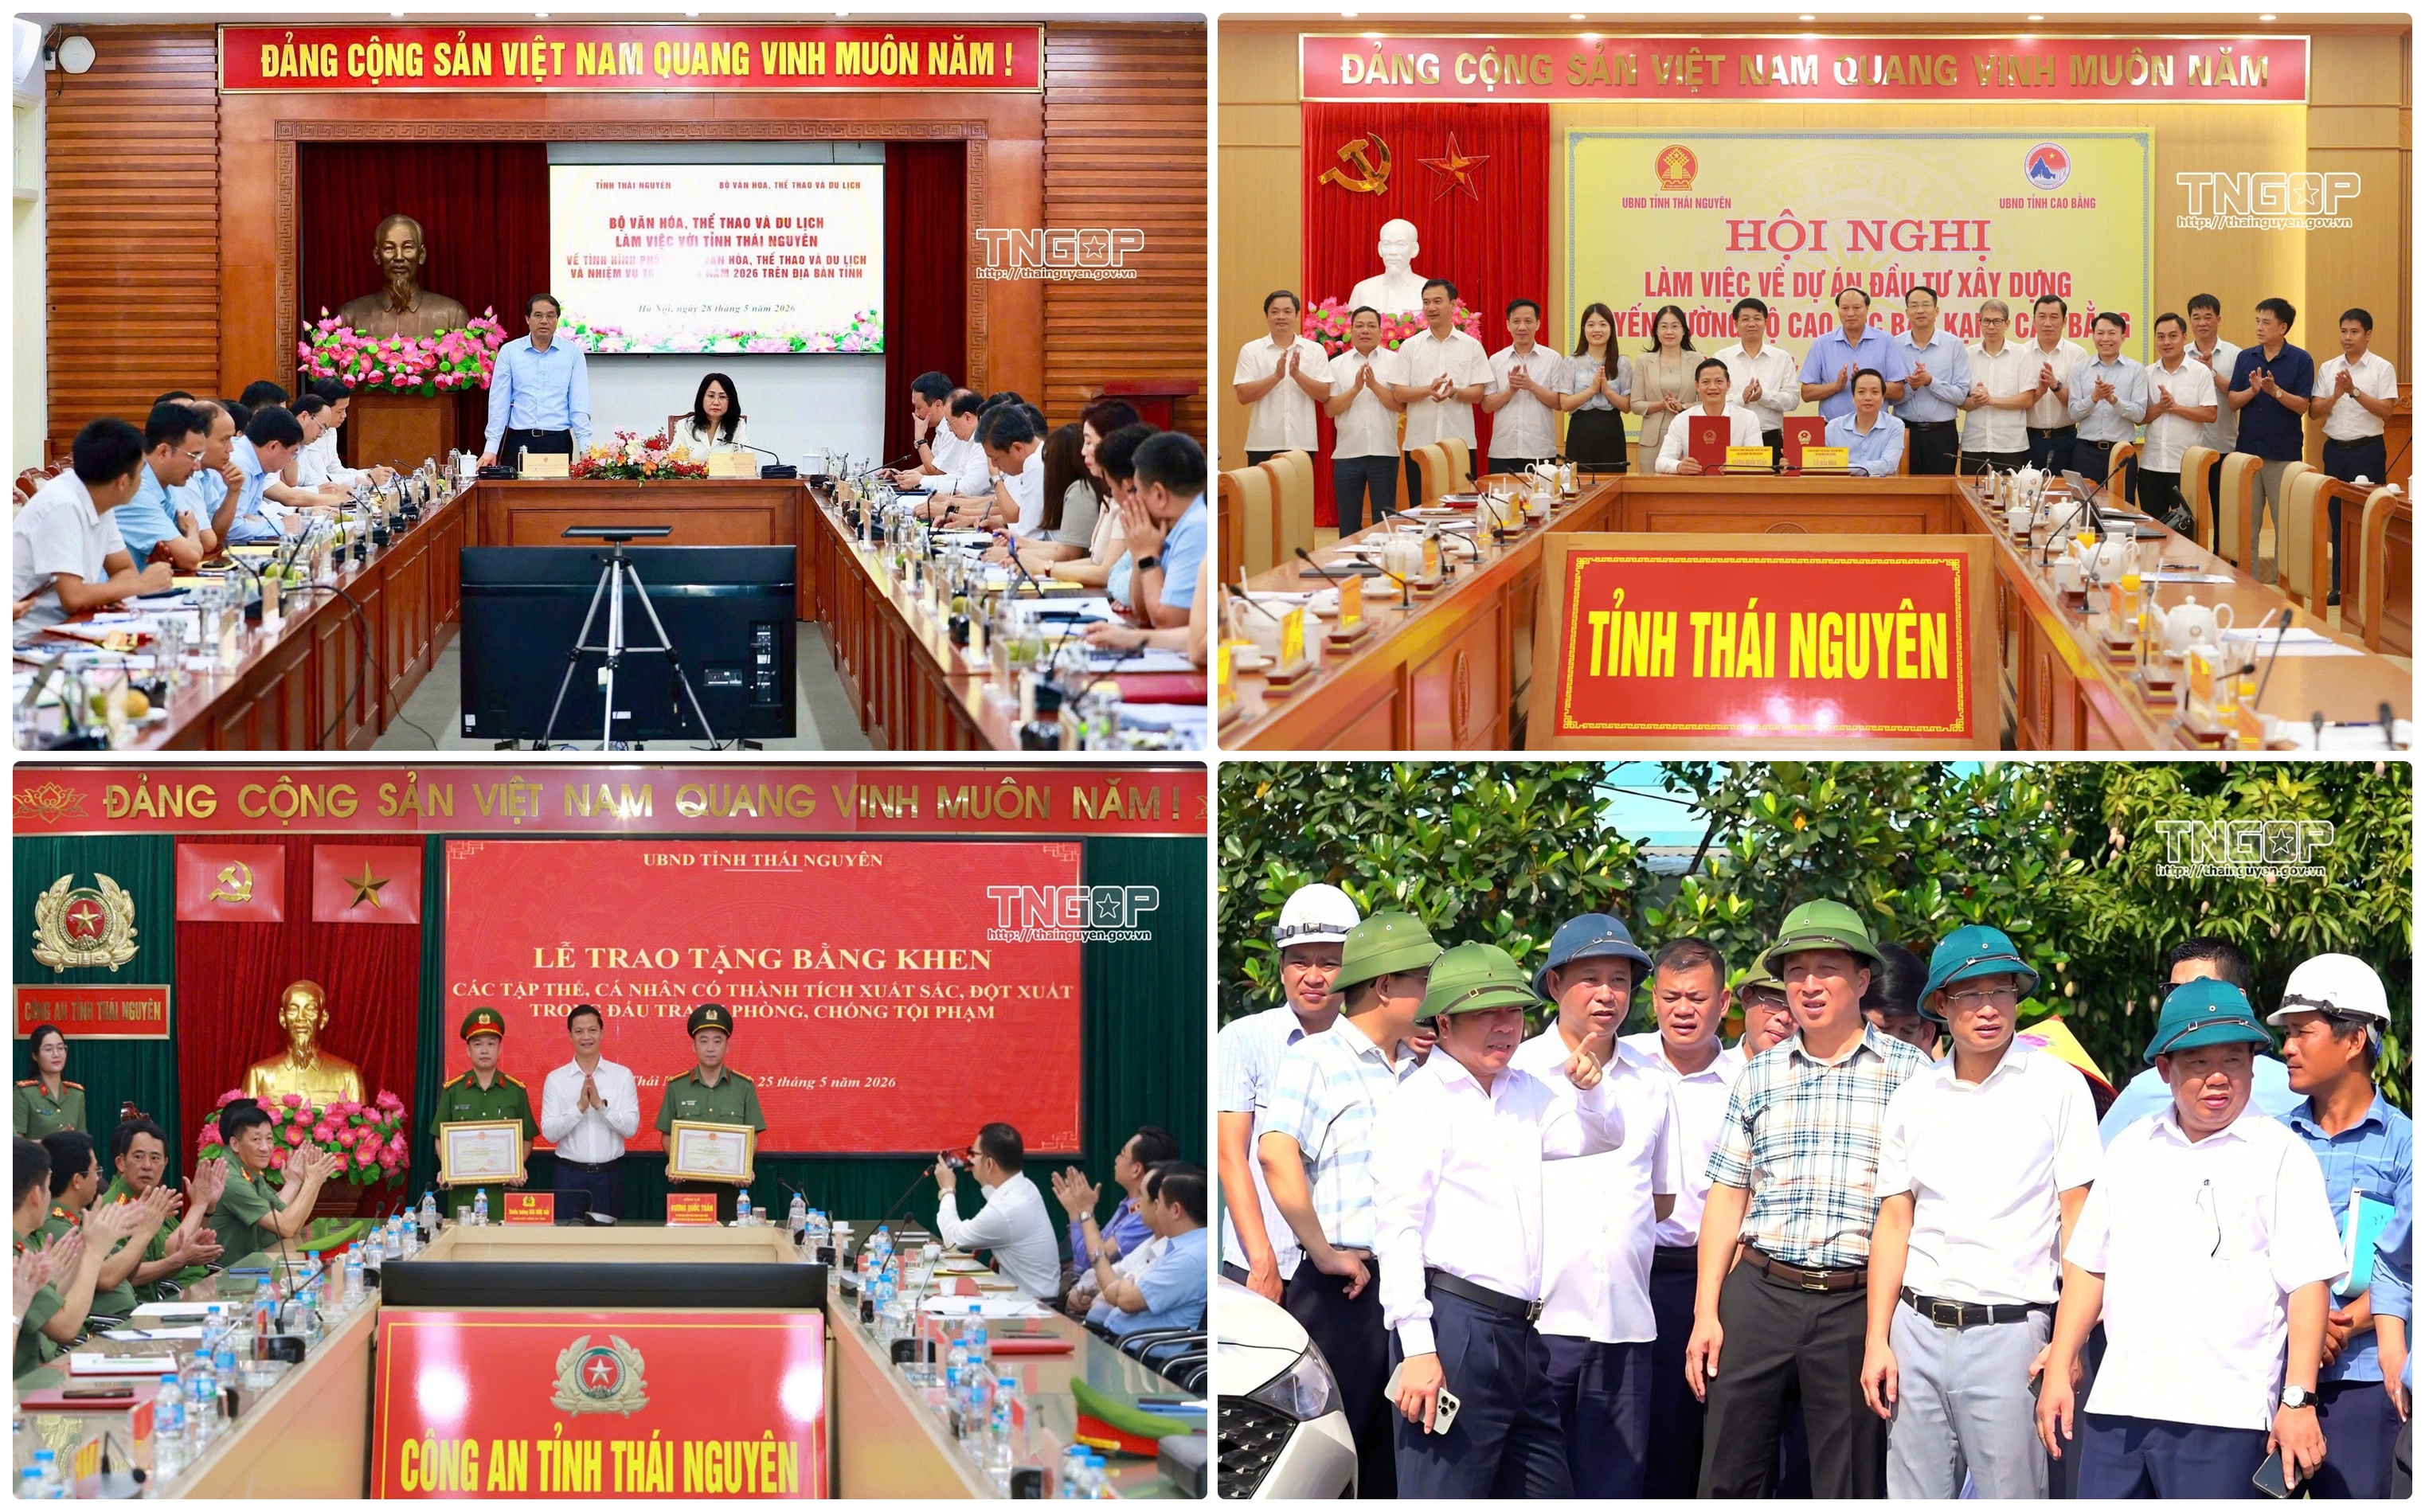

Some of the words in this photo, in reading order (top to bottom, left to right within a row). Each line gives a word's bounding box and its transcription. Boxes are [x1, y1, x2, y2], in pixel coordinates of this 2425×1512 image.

[261, 31, 338, 76] ĐẢNG
[348, 35, 423, 84] CỘNG
[434, 31, 491, 76] SẢN
[502, 35, 565, 82] VIỆT
[577, 42, 643, 75] NAM
[653, 41, 749, 76] QUANG
[761, 42, 825, 75] VINH
[836, 34, 917, 75] MUÔN
[929, 35, 994, 75] NĂM
[1005, 43, 1011, 76] !
[1340, 41, 1440, 85] ĐẢNG
[1454, 45, 1553, 92] CỘNG
[1566, 42, 1637, 85] SẢN
[1652, 47, 1726, 92] VIỆT
[1740, 54, 1818, 86] NAM
[1833, 54, 1958, 87] QUANG
[1973, 54, 2055, 87] VINH
[2071, 47, 2174, 87] MUÔN
[2188, 46, 2268, 87] NĂM
[596, 179, 614, 189] TỈNH
[617, 181, 636, 189] THÁI
[719, 180, 729, 190] BỘ
[733, 180, 749, 189] VĂN
[752, 180, 770, 189] HÓA,
[774, 179, 788, 189] THỂ
[816, 180, 825, 189] VÀ
[843, 182, 860, 190] LỊCH
[1623, 197, 1646, 208] UBND
[1651, 195, 1669, 208] TỈNH
[1674, 196, 1692, 208] THÁI
[1696, 196, 1731, 208] NGUYÊN
[2001, 198, 2023, 208] UBND
[2028, 195, 2047, 208] TỈNH
[2051, 198, 2067, 208] CAO
[2072, 195, 2096, 209] BẰNG
[609, 215, 625, 232] BỘ
[630, 215, 655, 229] VĂN
[659, 215, 687, 230] HÓA,
[693, 213, 715, 229] THỂ
[719, 217, 751, 229] THAO
[755, 215, 771, 229] VÀ
[776, 217, 792, 229] DU
[796, 217, 823, 231] LỊCH
[616, 233, 641, 248] LÀM
[646, 233, 673, 249] VIỆC
[679, 233, 698, 247] VỚI
[703, 233, 731, 247] TỈNH
[736, 233, 764, 247] THÁI
[769, 233, 818, 247] NGUYÊN
[1724, 209, 1829, 263] HỘI
[1849, 218, 1993, 263] NGHỊ
[567, 252, 579, 265] VỀ
[583, 254, 607, 265] TÌNH
[729, 253, 752, 266] HÓA,
[756, 252, 776, 265] THỂ
[779, 255, 805, 265] THAO
[809, 253, 822, 265] VÀ
[826, 255, 839, 265] DU
[843, 256, 866, 266] LỊCH
[571, 267, 584, 278] VÀ
[588, 267, 621, 280] NHIỆM
[733, 268, 758, 278] 2026
[762, 266, 788, 278] TRÊN
[792, 268, 809, 280] ĐỊA
[814, 266, 835, 278] BÀN
[839, 266, 862, 278] TỈNH
[1645, 266, 1692, 296] LÀM
[1701, 267, 1750, 303] VIỆC
[1758, 264, 1784, 297] VỀ
[1793, 270, 1825, 305] DỰ
[1831, 267, 1861, 297] ÁN
[1869, 264, 1915, 297] ĐẦU
[1922, 270, 1953, 298] TƯ
[1958, 268, 2001, 297] XÂY
[2010, 270, 2071, 305] DỰNG
[677, 305, 698, 314] ngày
[715, 305, 741, 314] tháng
[774, 304, 795, 314] 2026
[1788, 312, 1832, 338] CAO
[1588, 588, 1677, 677] TỈNH
[1690, 598, 1776, 678] THÁI
[1789, 598, 1947, 679] NGUYÊN
[103, 774, 217, 818] ĐẢNG
[238, 776, 358, 825] CỘNG
[378, 772, 453, 816] SẢN
[473, 776, 542, 824] VIỆT
[565, 783, 651, 817] NAM
[676, 783, 816, 817] QUANG
[832, 784, 917, 818] VINH
[937, 777, 1046, 818] MUÔN
[1074, 780, 1159, 819] NĂM
[1172, 783, 1179, 819] !
[643, 854, 694, 865] UBND
[700, 851, 745, 865] TỈNH
[752, 851, 796, 866] THÁI
[804, 851, 882, 866] NGUYÊN
[534, 941, 575, 968] LỄ
[585, 947, 679, 969] TRAO
[688, 945, 782, 975] TẶNG
[793, 943, 886, 970] BẰNG
[896, 949, 992, 970] KHEN
[453, 979, 495, 996] CÁC
[500, 982, 539, 999] TẬP
[543, 981, 589, 998] THỂ,
[595, 980, 623, 996] CÁ
[629, 980, 686, 996] NHÂN
[692, 980, 721, 997] CÓ
[726, 981, 797, 997] THÀNH
[804, 981, 852, 998] TÍCH
[860, 982, 915, 998] XUẤT
[921, 982, 964, 999] SẮC,
[970, 984, 1011, 1001] ĐỘT
[1018, 986, 1074, 999] XUẤT
[24, 998, 50, 1021] CÔNG
[54, 1002, 68, 1021] AN
[72, 998, 94, 1021] TỈNH
[97, 997, 119, 1021] THÁI
[122, 998, 161, 1021] NGUYÊN
[608, 1001, 649, 1018] ĐẤU
[733, 1000, 808, 1020] PHÒNG,
[814, 1002, 887, 1018] CHỐNG
[894, 1004, 928, 1022] TỘI
[936, 1006, 995, 1022] PHẠM
[758, 1076, 773, 1087] 25
[777, 1076, 816, 1089] tháng
[819, 1077, 827, 1087] 5
[831, 1077, 860, 1087] năm
[864, 1077, 895, 1087] 2026
[401, 1429, 479, 1491] CÔNG
[487, 1440, 528, 1491] AN
[537, 1422, 601, 1492] TỈNH
[611, 1429, 674, 1492] THÁI
[683, 1430, 798, 1493] NGUYÊN
